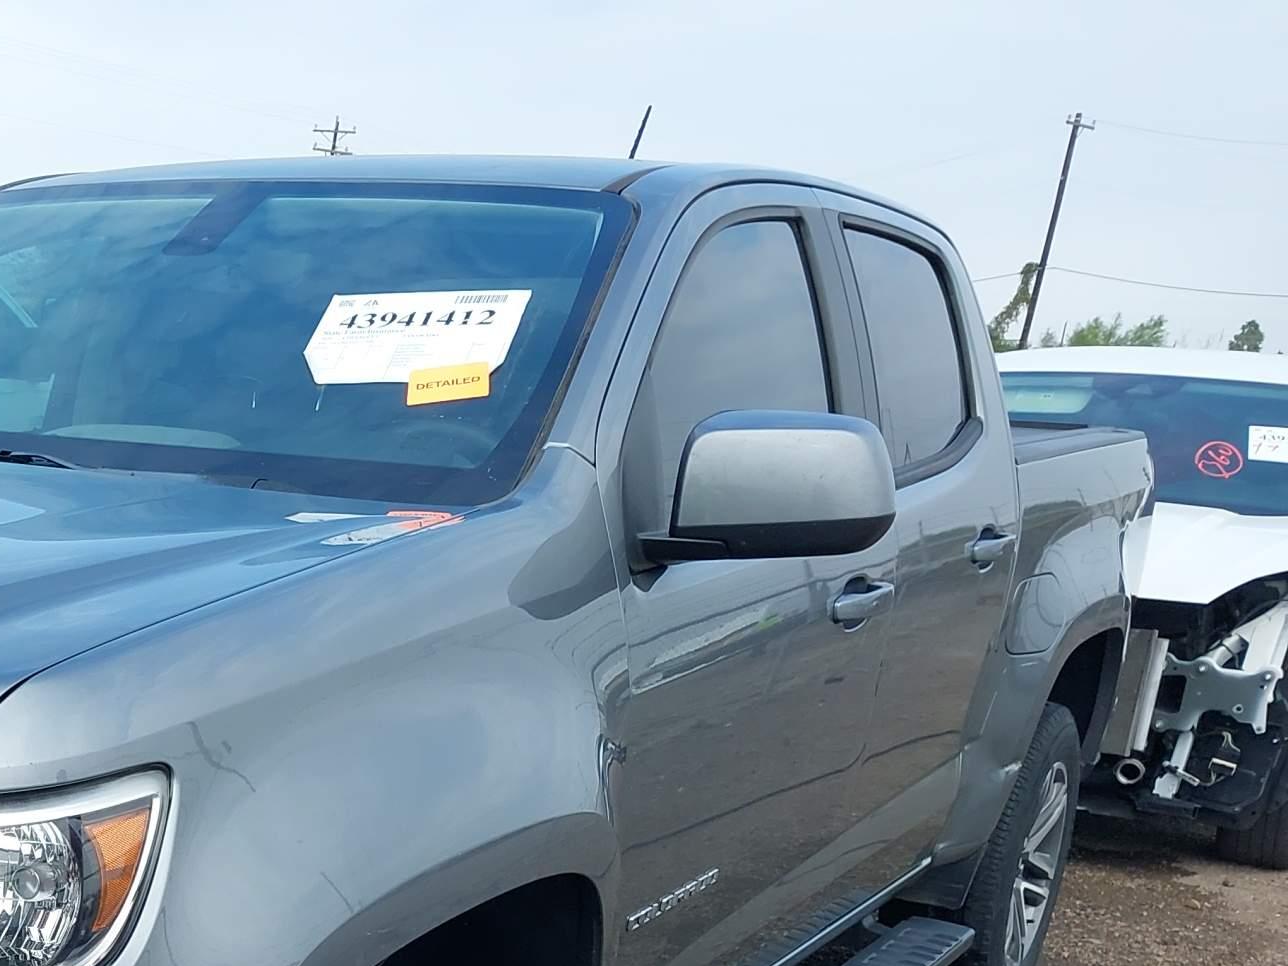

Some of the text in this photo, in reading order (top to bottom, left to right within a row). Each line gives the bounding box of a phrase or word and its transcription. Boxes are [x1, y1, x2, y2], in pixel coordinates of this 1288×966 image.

[339, 309, 496, 329] 43941412
[415, 375, 481, 391] DETAILED
[626, 867, 720, 932] COLORADO
